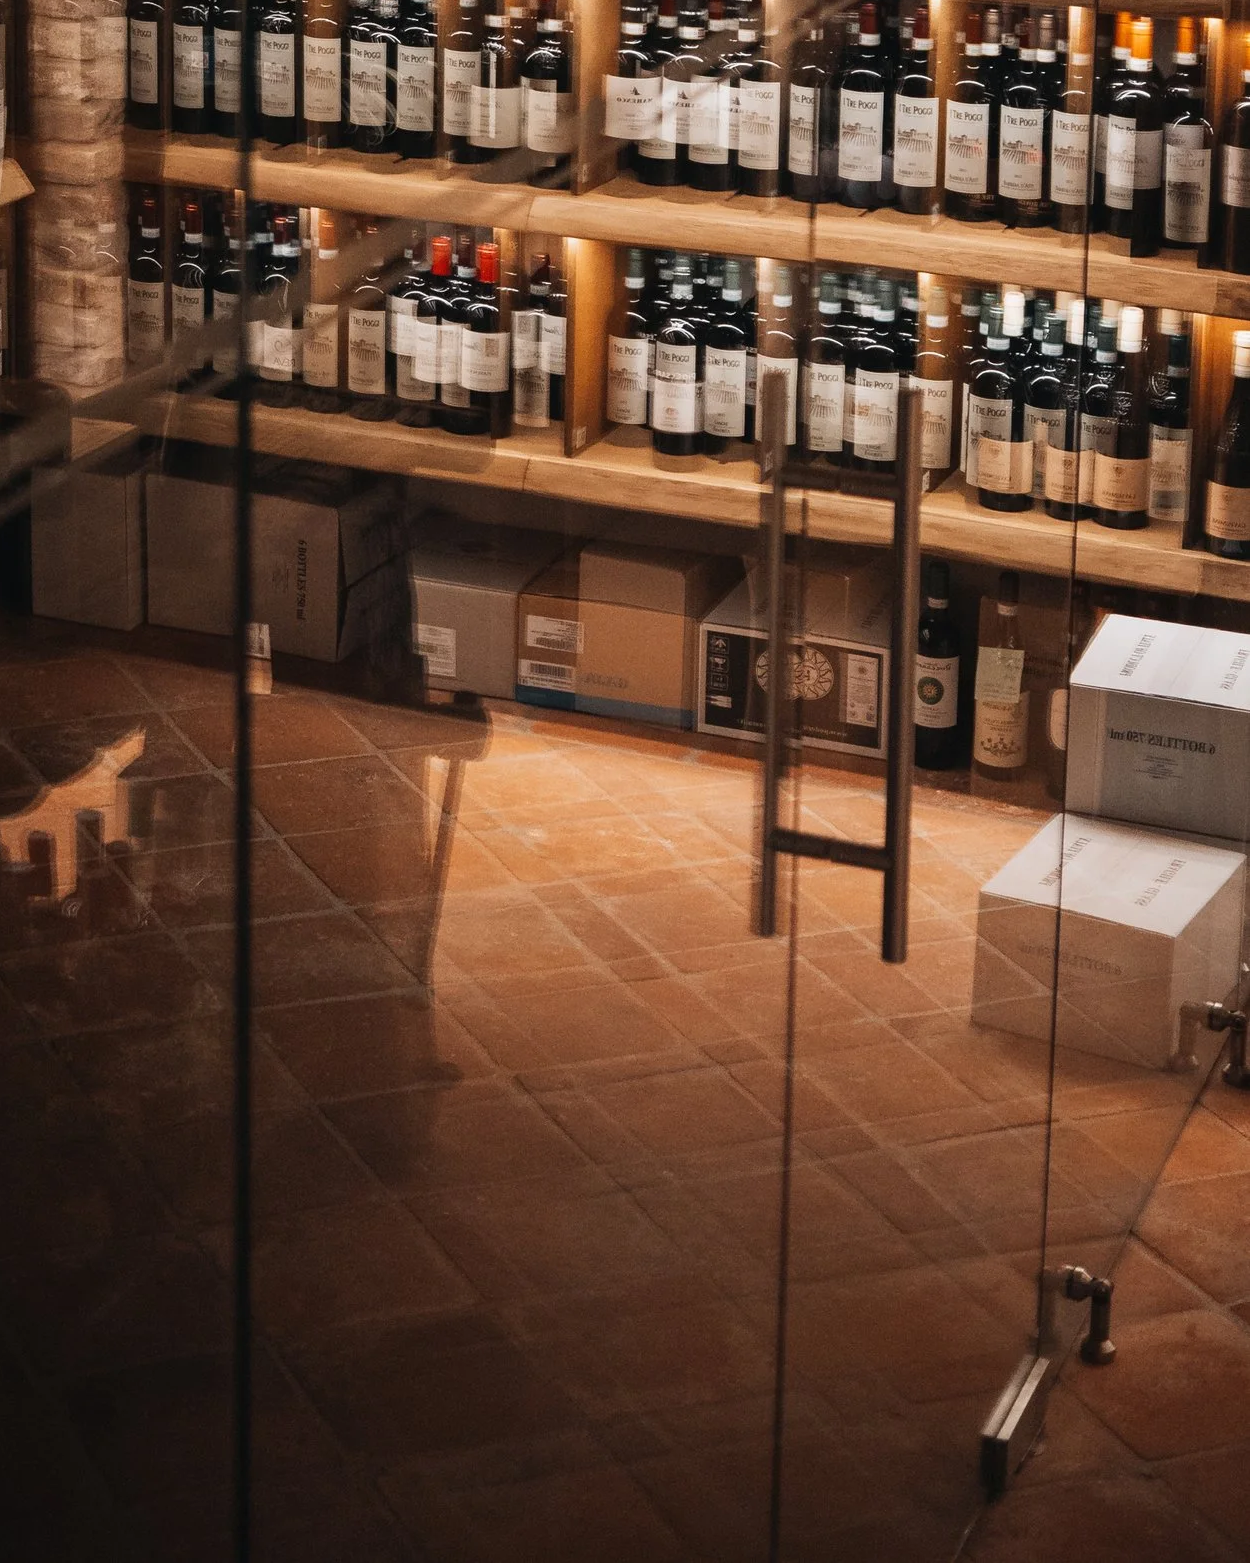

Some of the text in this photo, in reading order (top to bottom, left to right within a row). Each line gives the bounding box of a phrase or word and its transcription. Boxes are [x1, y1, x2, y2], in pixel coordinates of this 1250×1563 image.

[308, 44, 336, 55] TRE POGGI
[354, 48, 381, 59] TRE POGGI
[401, 52, 410, 61] TRE
[458, 58, 476, 68] POGGI
[847, 98, 856, 108] TRE
[858, 99, 878, 110] POGGI
[902, 104, 933, 115] TRE POGGI
[953, 110, 983, 121] TRE POGGI
[1007, 115, 1017, 125] TRE
[1019, 117, 1038, 127] POGGI
[1059, 120, 1069, 130] TRE
[614, 344, 623, 354] TRE
[662, 350, 690, 362] TRE POGGI
[722, 357, 741, 367] POGGI
[818, 372, 838, 382] POGGI
[874, 380, 894, 390] POGGI
[975, 405, 985, 415] TRE
[986, 406, 1006, 417] POGGI
